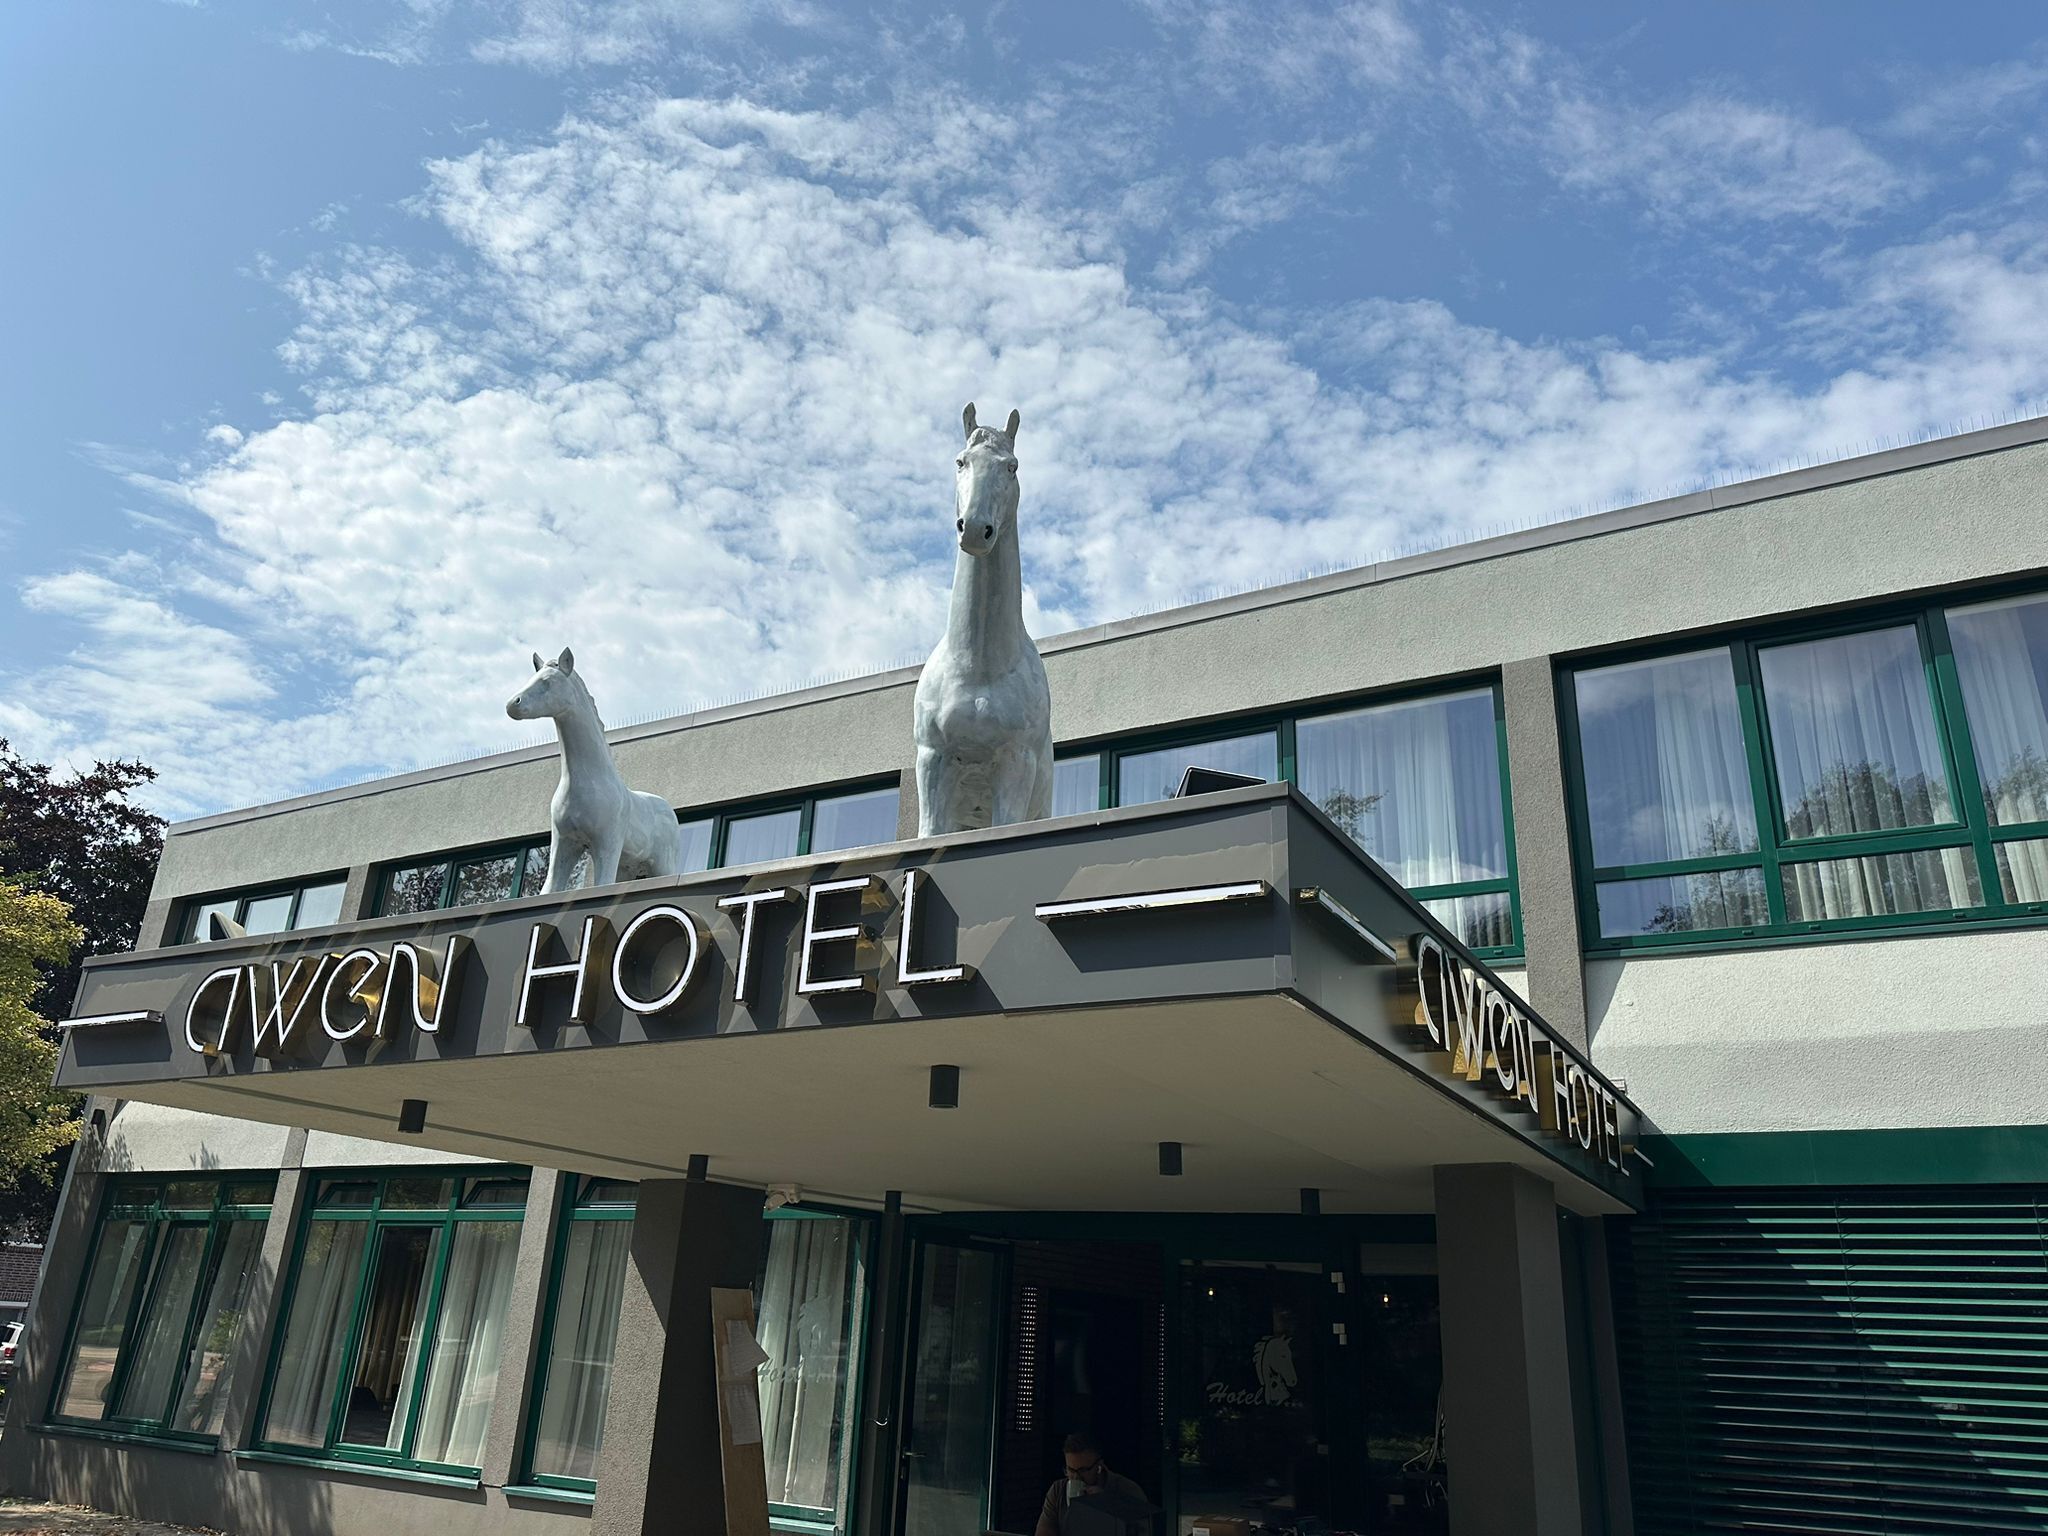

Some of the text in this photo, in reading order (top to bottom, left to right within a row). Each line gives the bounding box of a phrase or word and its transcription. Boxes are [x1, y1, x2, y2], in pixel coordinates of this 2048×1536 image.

[515, 869, 965, 1027] HOTEL
[1549, 1039, 1630, 1176] HOTEL
[1206, 1382, 1264, 1405] Hotel
